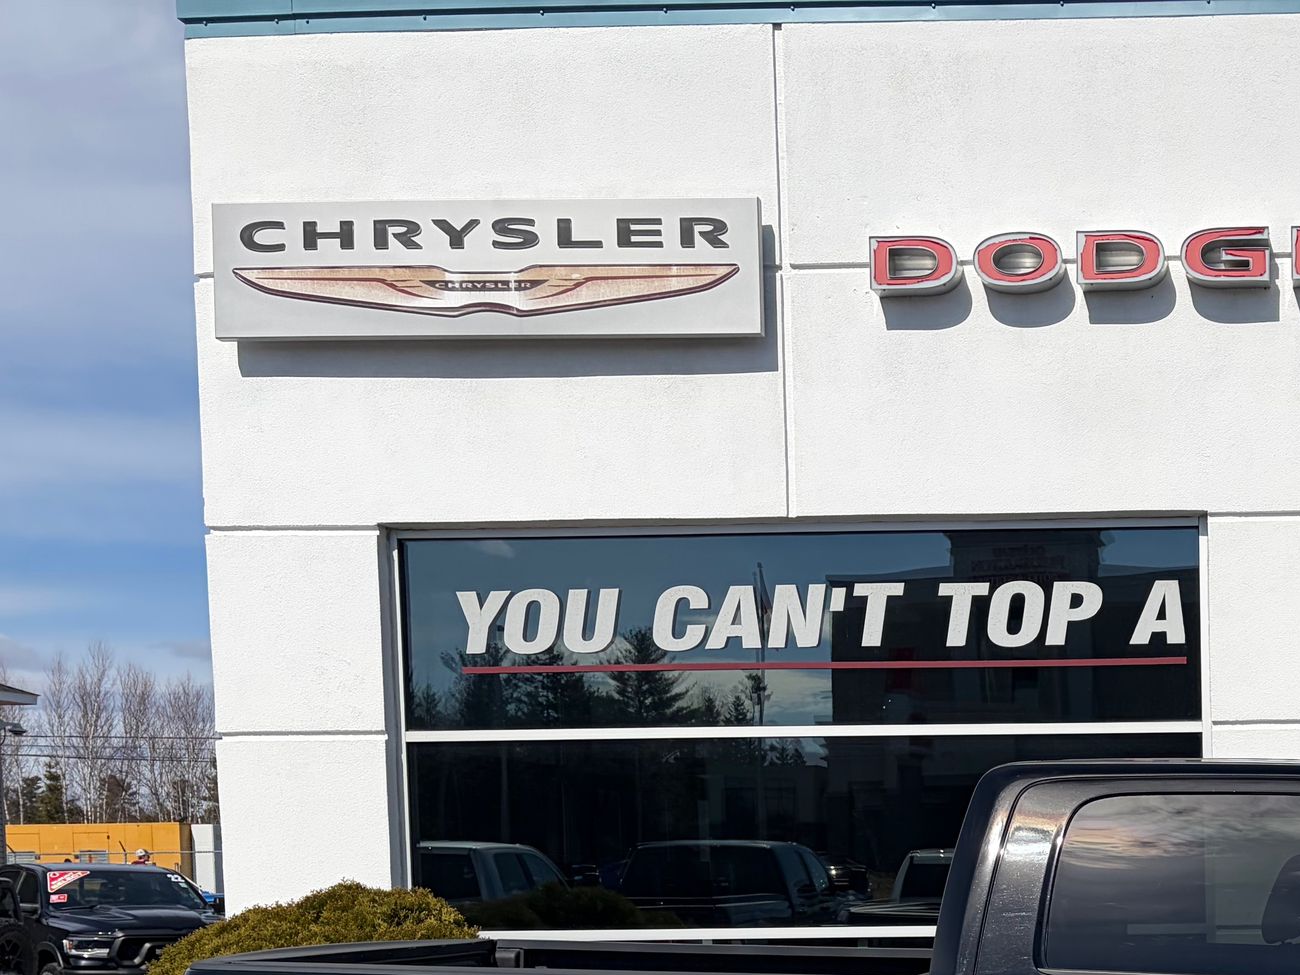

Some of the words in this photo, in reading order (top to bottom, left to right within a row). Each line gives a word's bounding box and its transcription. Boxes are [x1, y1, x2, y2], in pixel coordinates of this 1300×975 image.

[239, 217, 731, 253] CHRYSLER
[435, 281, 531, 289] CHRYSLER
[456, 588, 620, 655] YOU
[652, 583, 904, 652] CAN'T
[938, 581, 1104, 648] TOP
[1130, 579, 1187, 646] A
